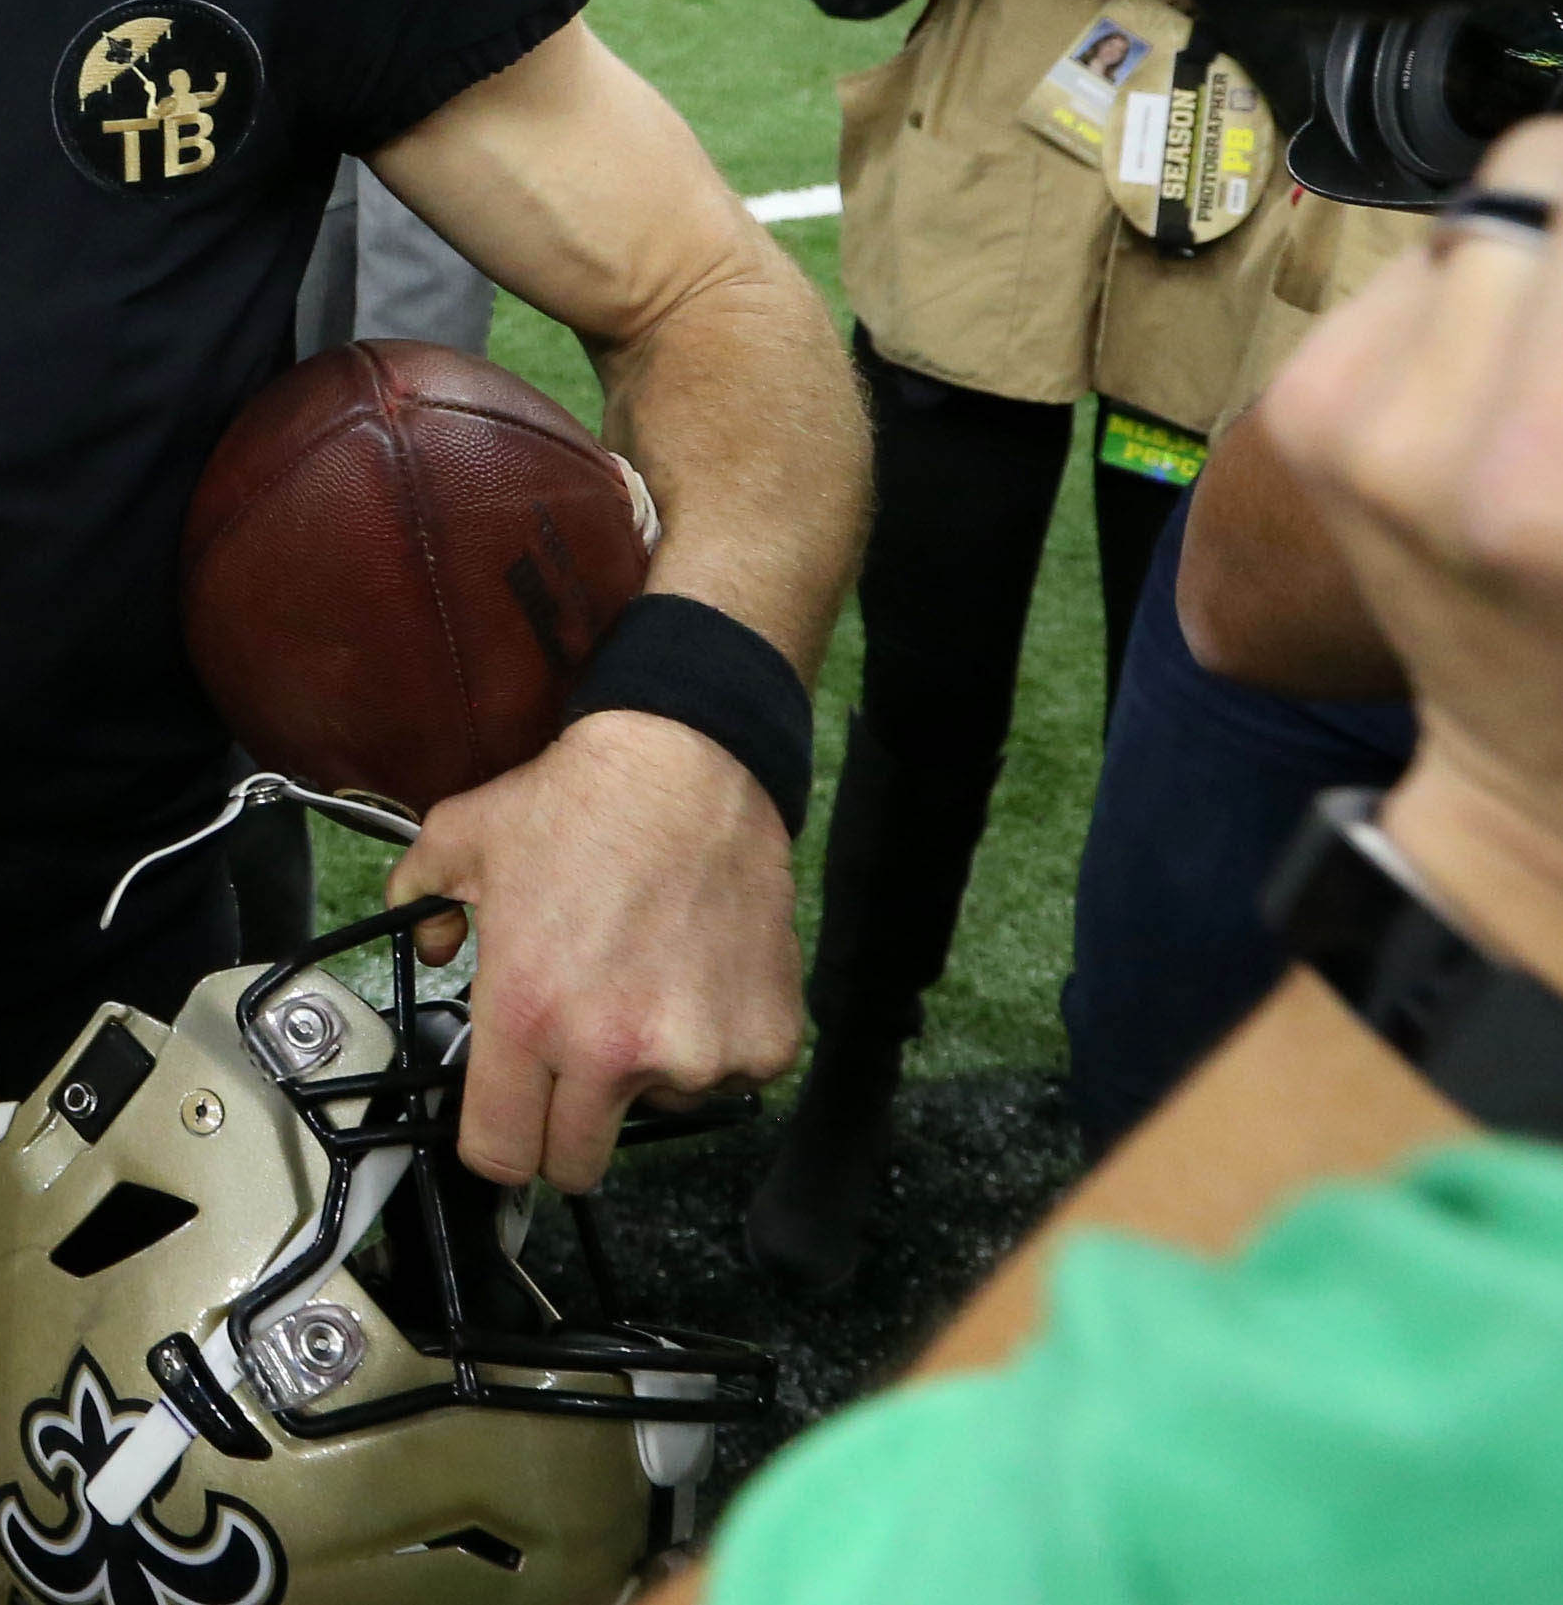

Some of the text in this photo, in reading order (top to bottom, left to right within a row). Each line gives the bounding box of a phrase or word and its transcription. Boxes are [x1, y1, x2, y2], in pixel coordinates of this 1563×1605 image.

[102, 112, 217, 183] TB
[1161, 87, 1200, 200] SEASON
[1196, 72, 1230, 223] PHOTOGRAPHER
[1222, 127, 1256, 173] PB
